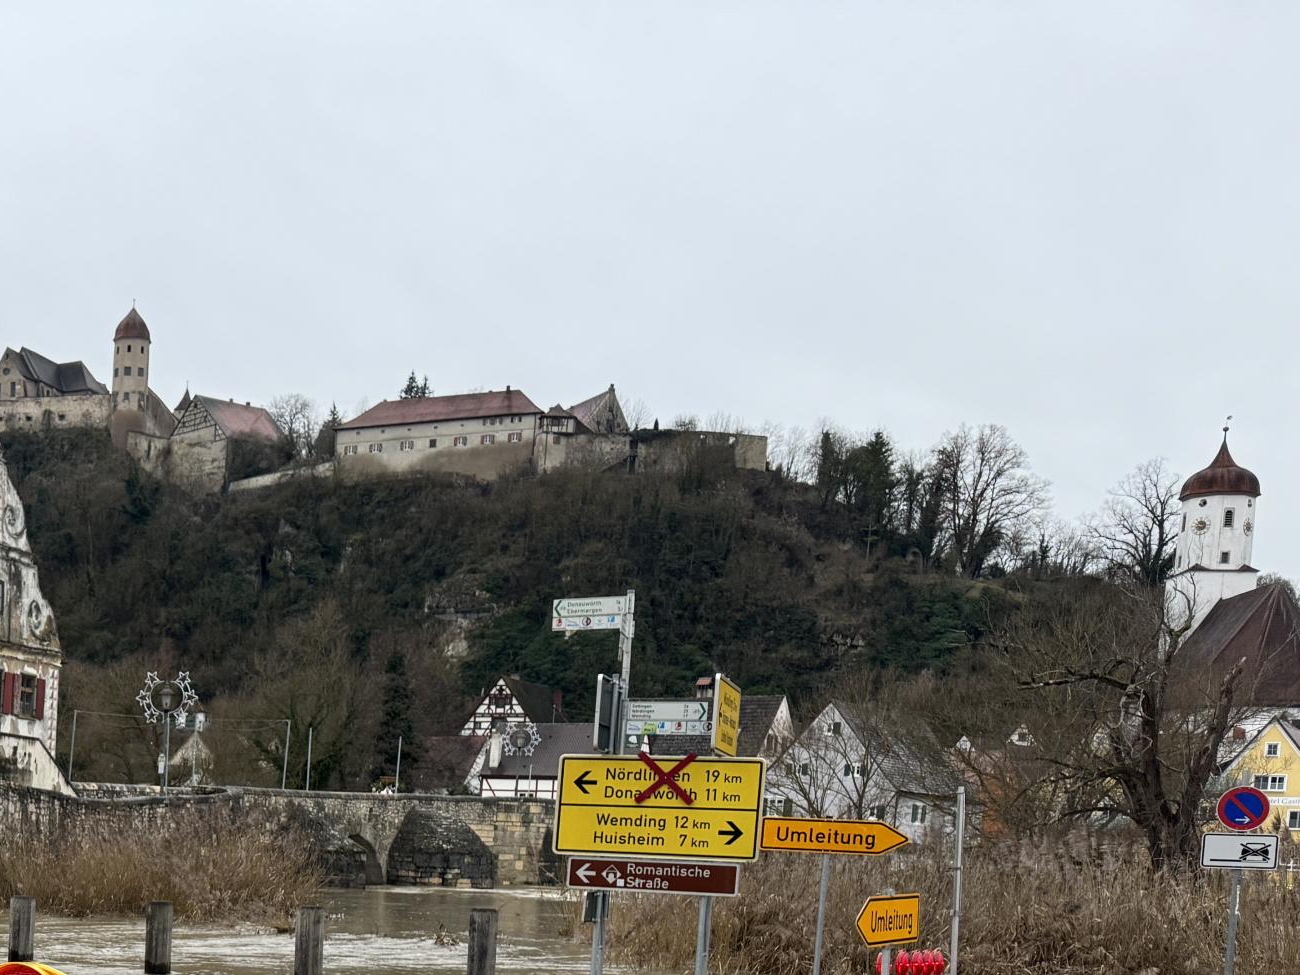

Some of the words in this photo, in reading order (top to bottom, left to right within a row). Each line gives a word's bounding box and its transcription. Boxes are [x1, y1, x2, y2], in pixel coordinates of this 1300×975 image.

[705, 770, 720, 783] 19
[724, 773, 742, 784] km
[705, 788, 717, 802] 11
[723, 791, 741, 802] km
[596, 813, 666, 830] Wemding
[674, 816, 688, 829] 12
[693, 819, 711, 830] km
[593, 832, 665, 847] Huisheim
[679, 835, 687, 847] 7
[691, 838, 709, 848] km
[776, 826, 876, 849] Umleitung
[627, 863, 711, 878] Romantische
[626, 876, 669, 890] Straße
[871, 908, 913, 934] Umleitung
